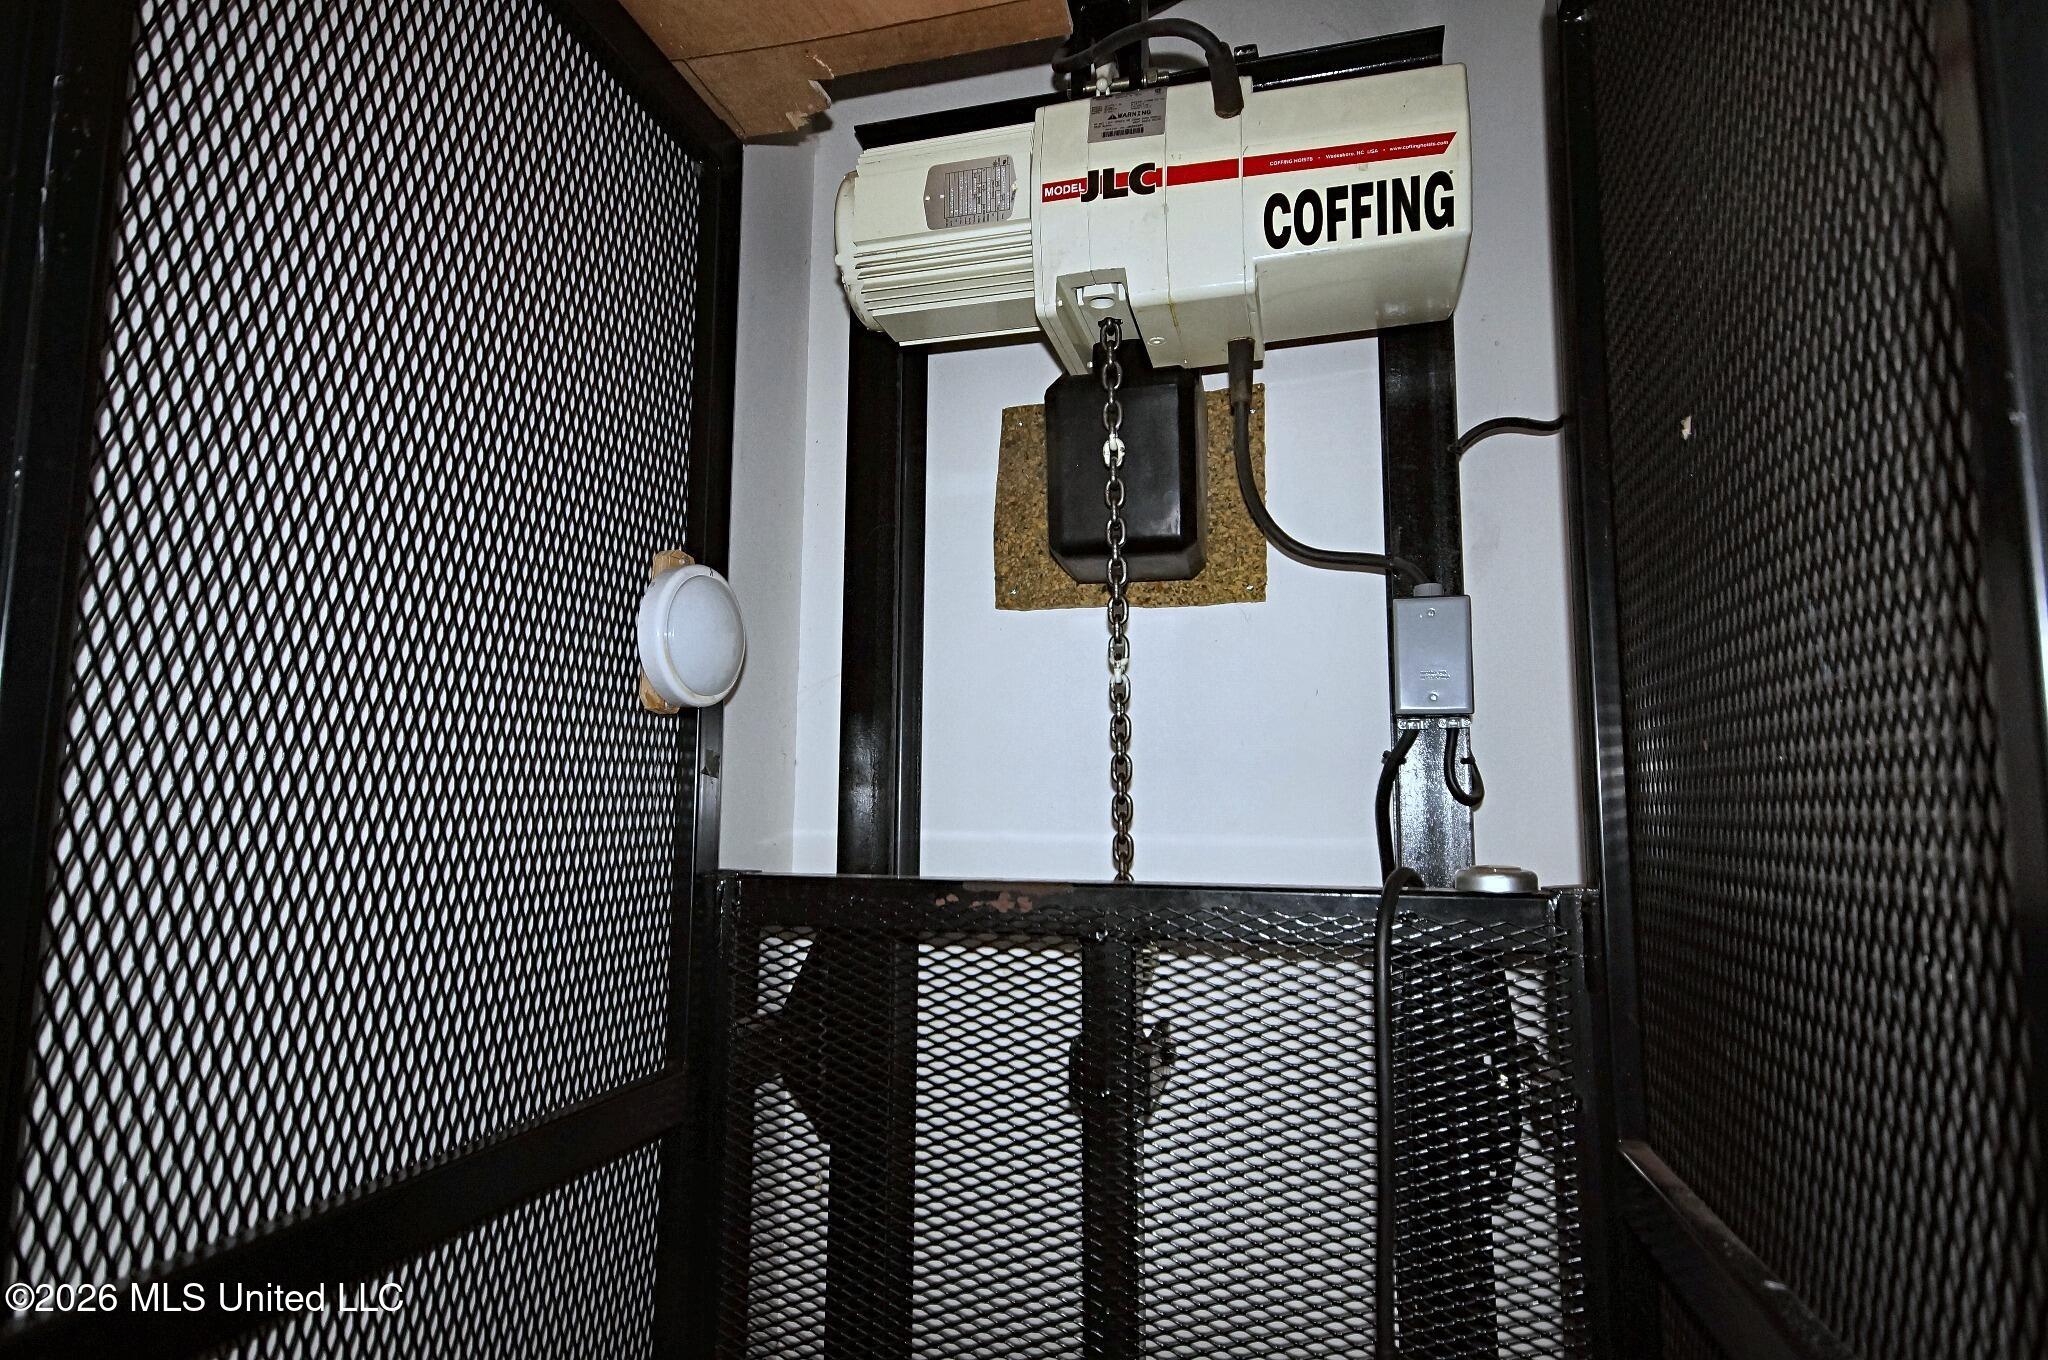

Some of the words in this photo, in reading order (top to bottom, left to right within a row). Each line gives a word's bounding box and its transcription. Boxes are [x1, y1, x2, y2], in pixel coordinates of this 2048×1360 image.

[1117, 110, 1152, 119] WARNING
[1269, 158, 1293, 167] COFFING
[1293, 156, 1314, 164] HOISTS
[1044, 182, 1086, 198] MODEL
[1081, 162, 1156, 203] JLC
[1263, 170, 1455, 250] COFFING
